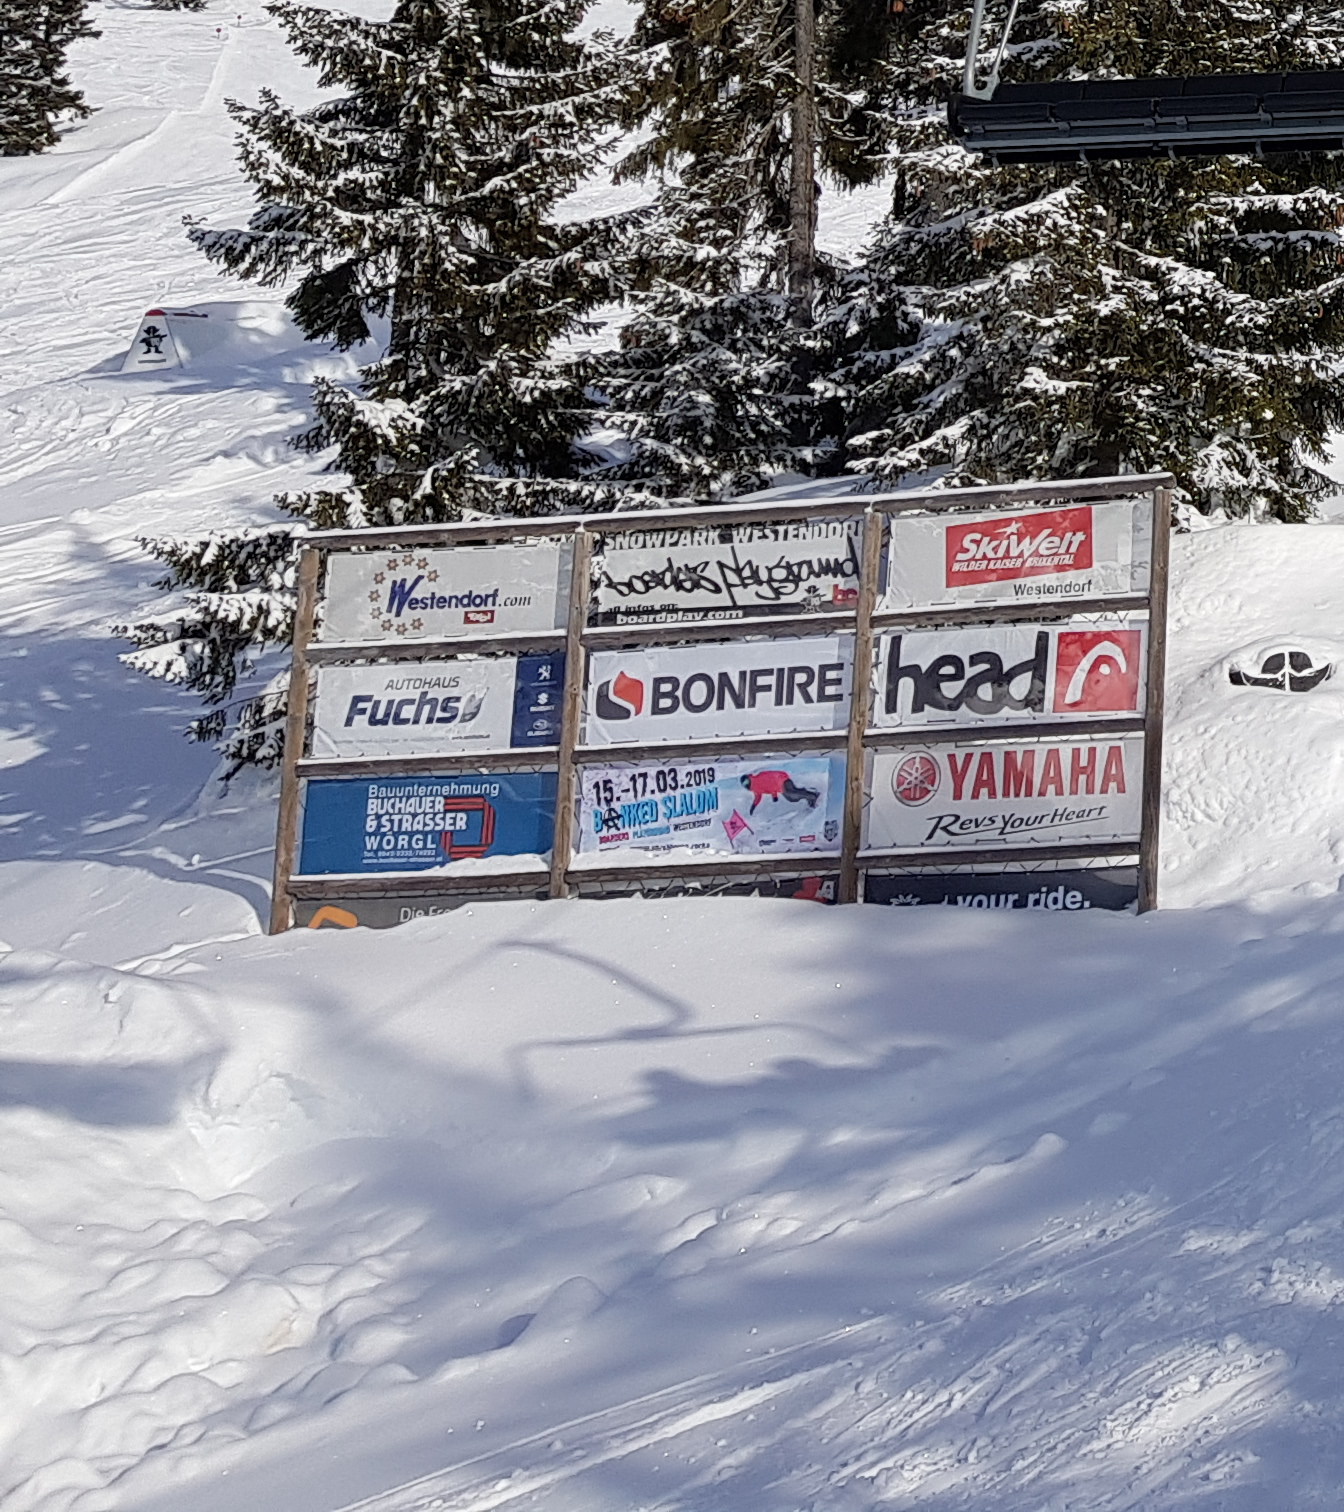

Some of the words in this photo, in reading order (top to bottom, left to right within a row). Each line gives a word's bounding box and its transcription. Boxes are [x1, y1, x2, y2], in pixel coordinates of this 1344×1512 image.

[604, 528, 722, 551] SNOWPARK
[955, 528, 1087, 561] SkiWelt
[1013, 579, 1093, 597] Westendorf
[385, 676, 461, 691] AUTOHAUS
[885, 631, 1050, 715] head
[651, 662, 845, 716] BONFIRE
[344, 691, 463, 728] Fuchs
[947, 745, 1126, 801] YAMAHA
[368, 782, 500, 798] Bauunternehmung
[367, 796, 446, 815] BUCHAUER
[593, 798, 659, 833] BANKED
[662, 787, 719, 819] SLALOM
[365, 815, 378, 833] &
[380, 812, 467, 833] STRASSER
[365, 832, 437, 850] WÖRGL
[1027, 885, 1091, 910] ride.
[399, 906, 425, 923] Die
